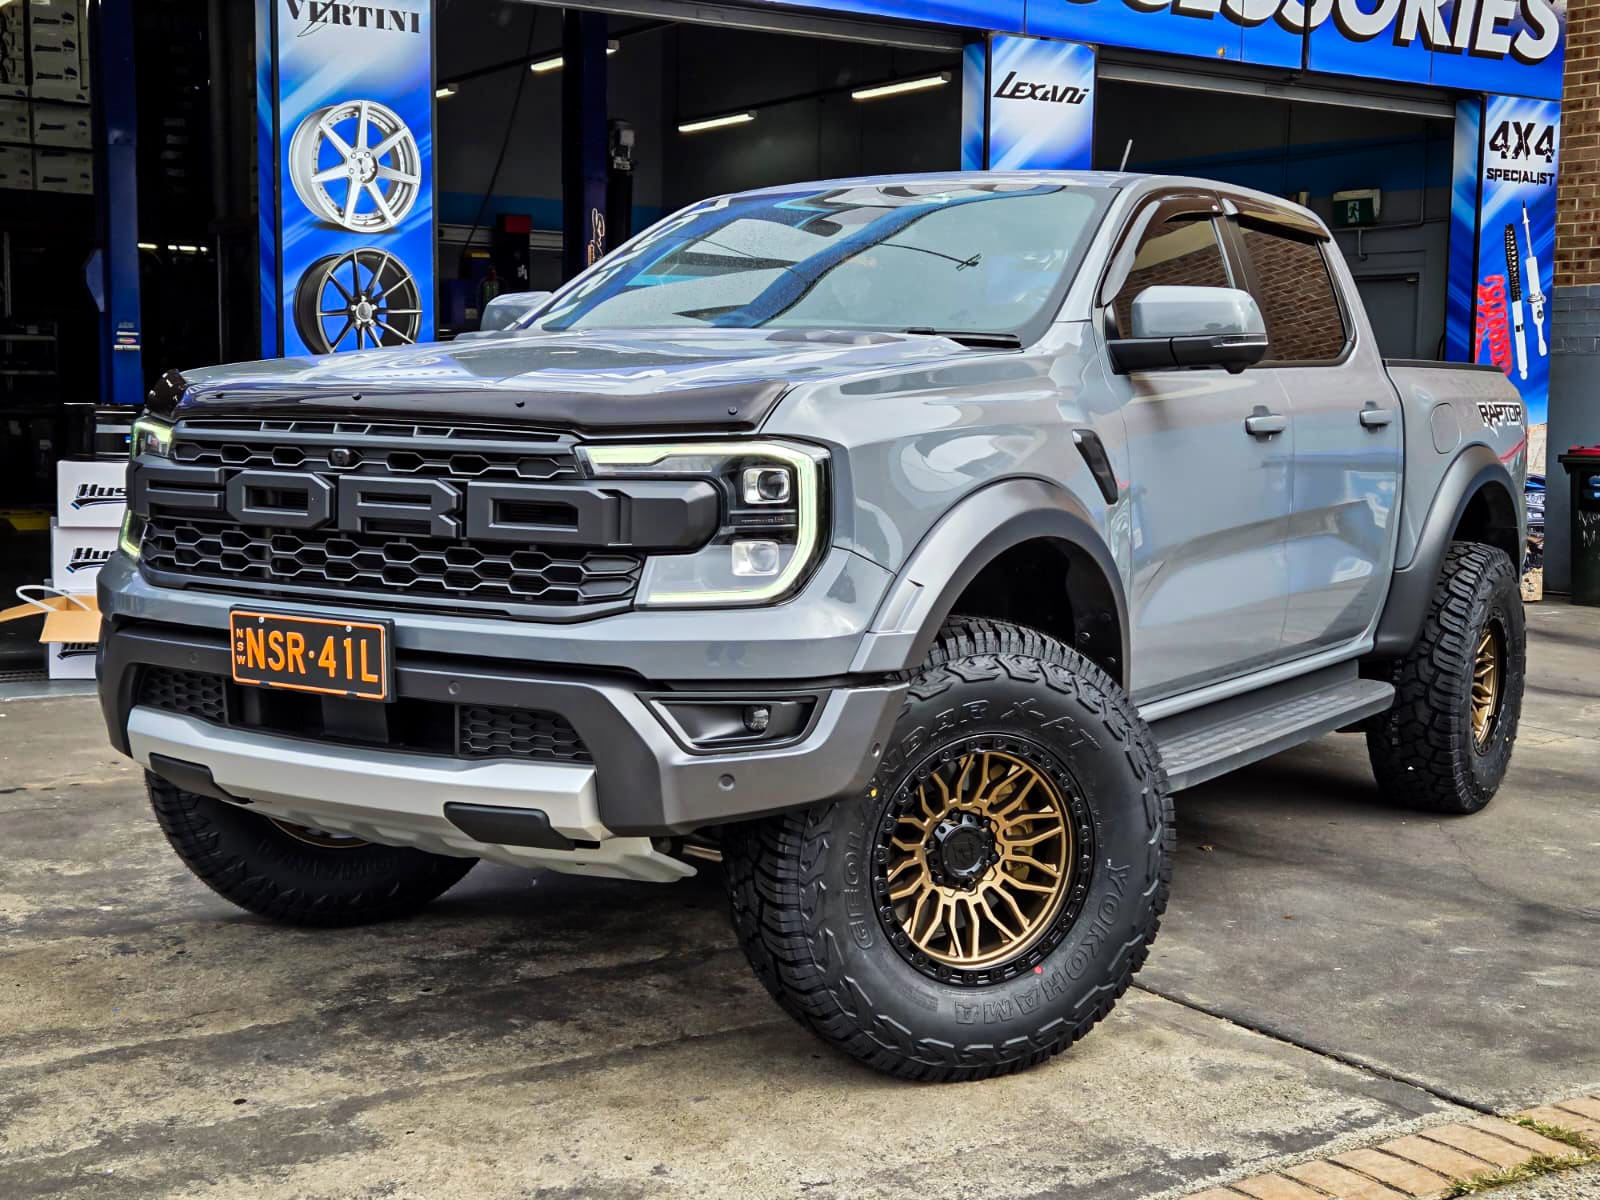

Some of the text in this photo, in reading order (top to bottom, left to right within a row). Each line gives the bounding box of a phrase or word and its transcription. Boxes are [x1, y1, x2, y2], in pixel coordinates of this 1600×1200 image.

[284, 0, 421, 36] VERTINI
[1488, 120, 1556, 163] 4X4
[1486, 167, 1556, 186] SPECIALIST
[1477, 401, 1523, 434] RAPTOR
[132, 455, 634, 548] FORD
[235, 627, 247, 666] NSW
[954, 863, 1131, 1026] YOKOHAMA
